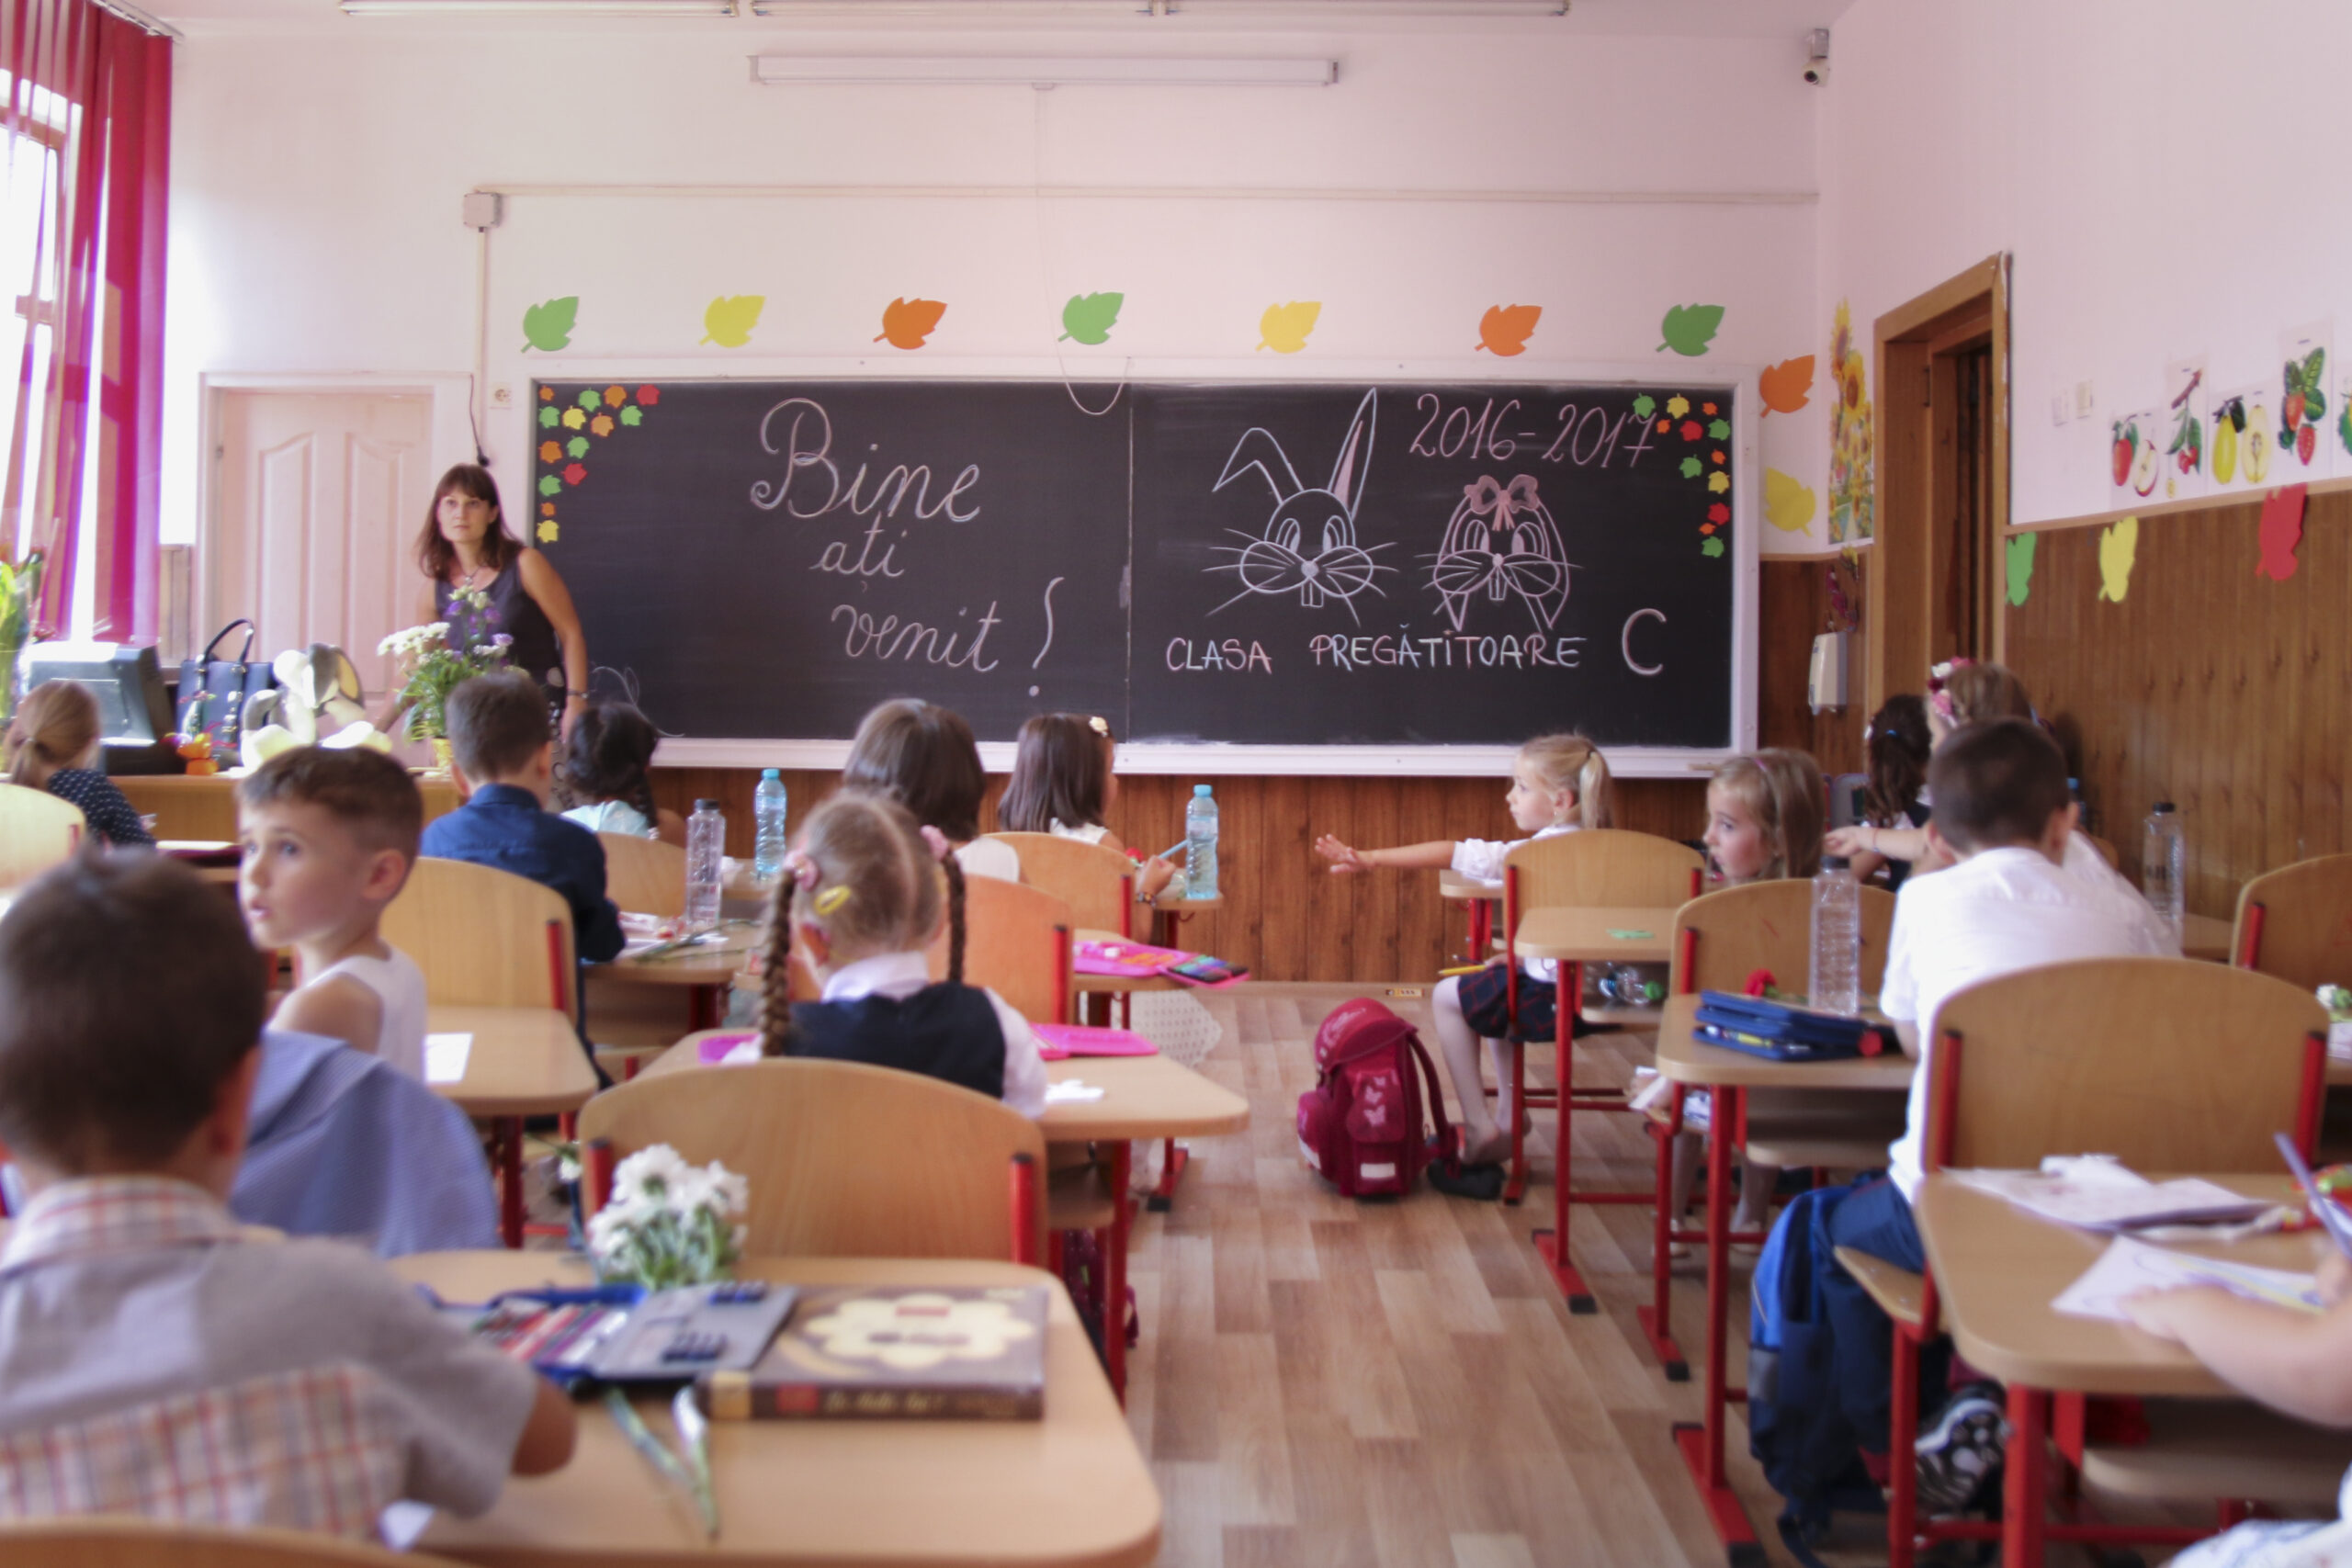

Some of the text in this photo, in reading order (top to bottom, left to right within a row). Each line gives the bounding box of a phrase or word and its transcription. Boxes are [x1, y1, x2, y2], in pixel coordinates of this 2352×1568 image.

[751, 398, 980, 521] Bine
[1409, 393, 1657, 468] 2016-2017
[831, 601, 1001, 672] venit
[1166, 637, 1272, 674] CLASA
[1622, 608, 1667, 676] C
